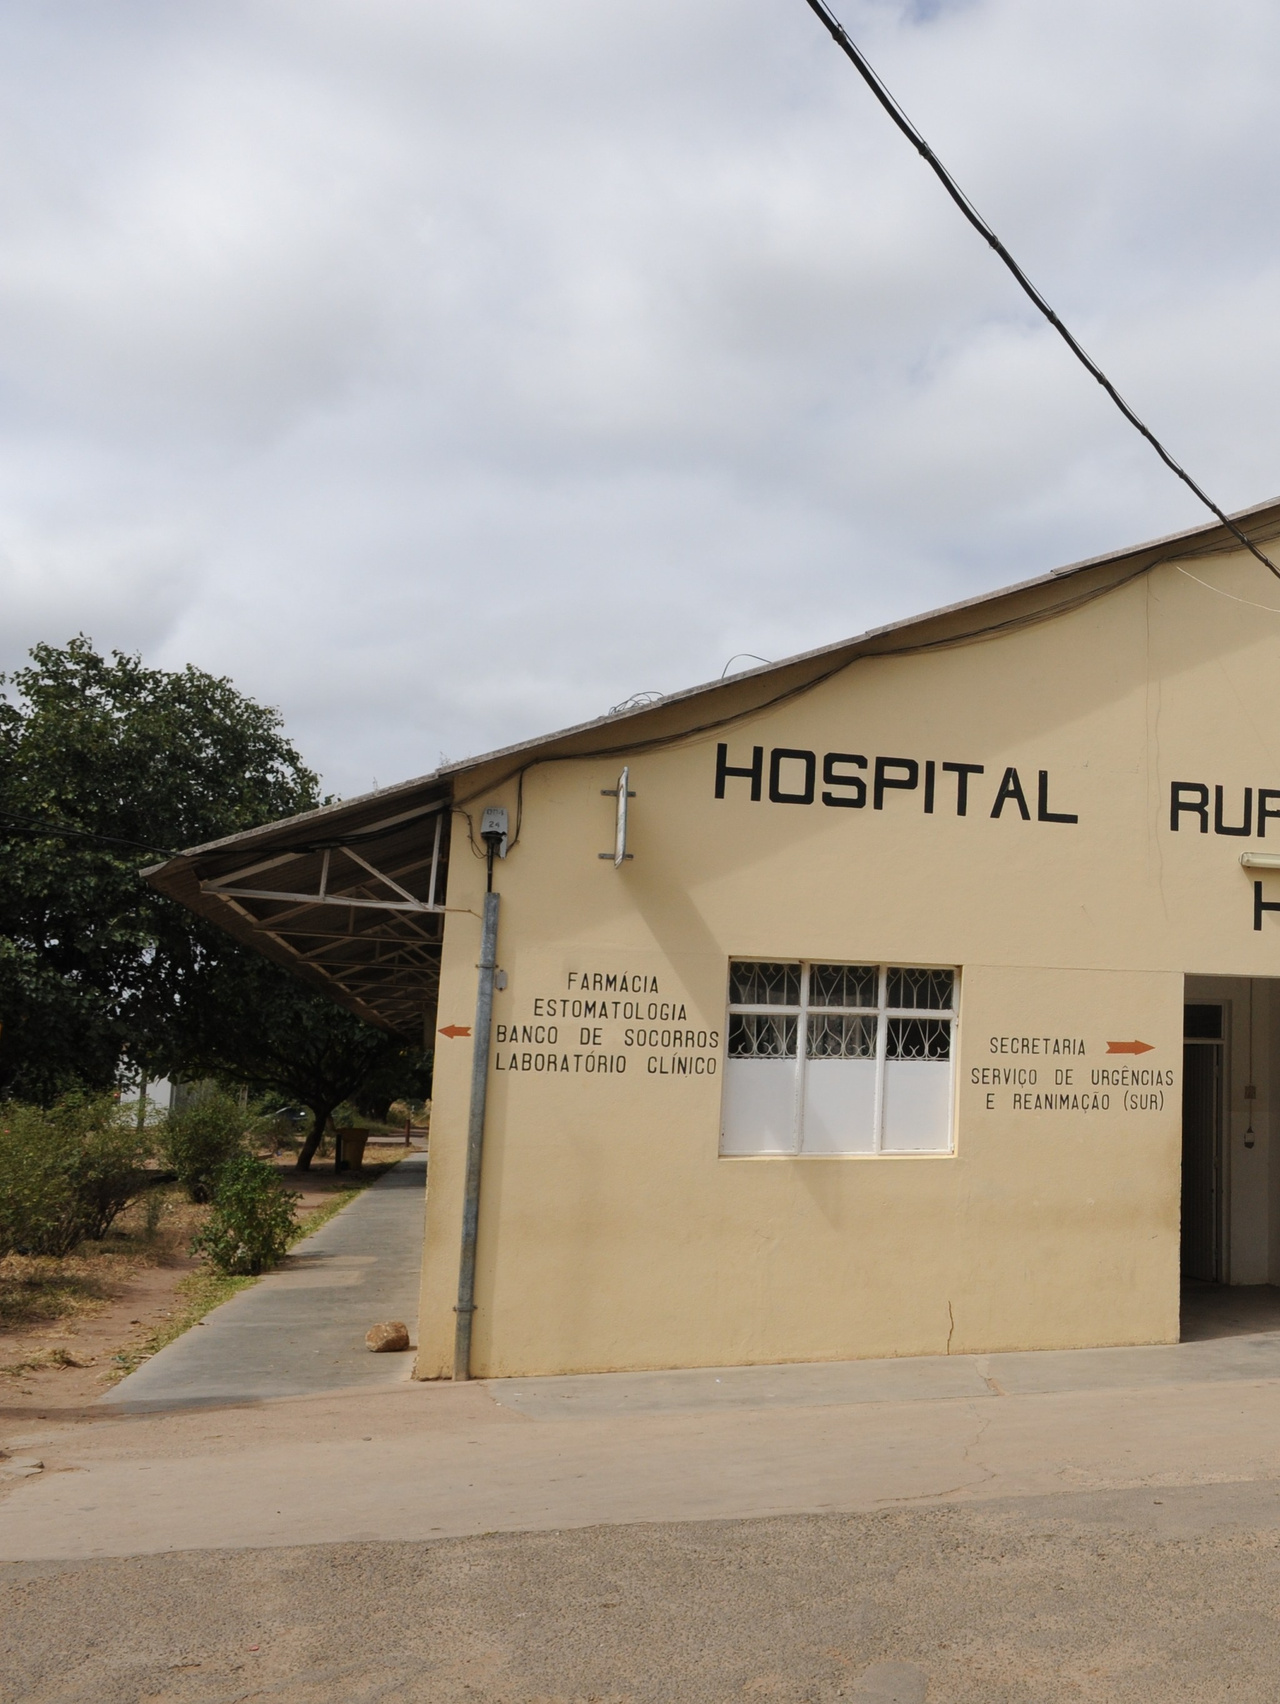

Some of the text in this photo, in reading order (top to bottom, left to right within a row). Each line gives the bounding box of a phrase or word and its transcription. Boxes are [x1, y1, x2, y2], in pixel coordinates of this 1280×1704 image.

[714, 742, 1079, 825] HOSPITAL
[567, 971, 659, 994] FARMÁCIA
[533, 997, 687, 1021] ESTOMATOLOGIA
[496, 1024, 720, 1049] BANCO DE SOCORROS
[989, 1036, 1086, 1056] SECRETARIA
[495, 1050, 717, 1075] LABORATÓRIO CLÍNICO
[971, 1065, 1174, 1088] SERVIÇO DE URGÊNCIAS
[986, 1089, 1164, 1113] E REANIMAÇÃO (SUR)
